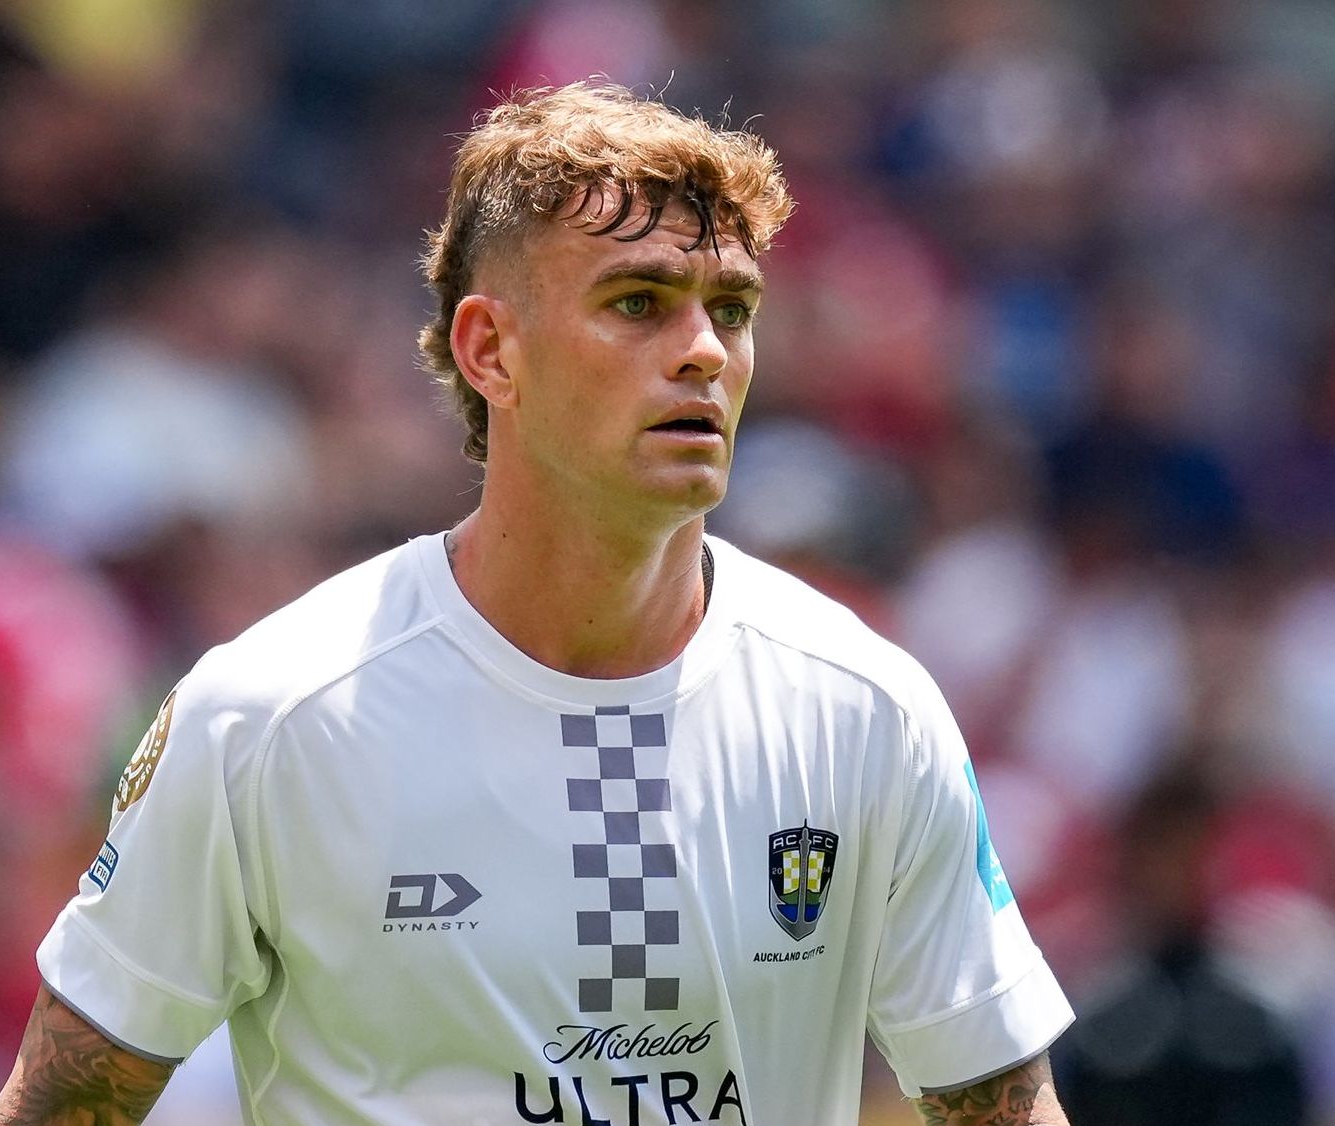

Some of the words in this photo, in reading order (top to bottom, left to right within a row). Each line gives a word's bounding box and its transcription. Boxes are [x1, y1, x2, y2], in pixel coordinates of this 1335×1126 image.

[772, 834, 798, 850] AC
[812, 835, 835, 849] FC
[382, 921, 480, 933] DYNASTY
[753, 952, 801, 963] AUCKLAND
[802, 948, 816, 961] CITY
[542, 1019, 720, 1065] Michelob
